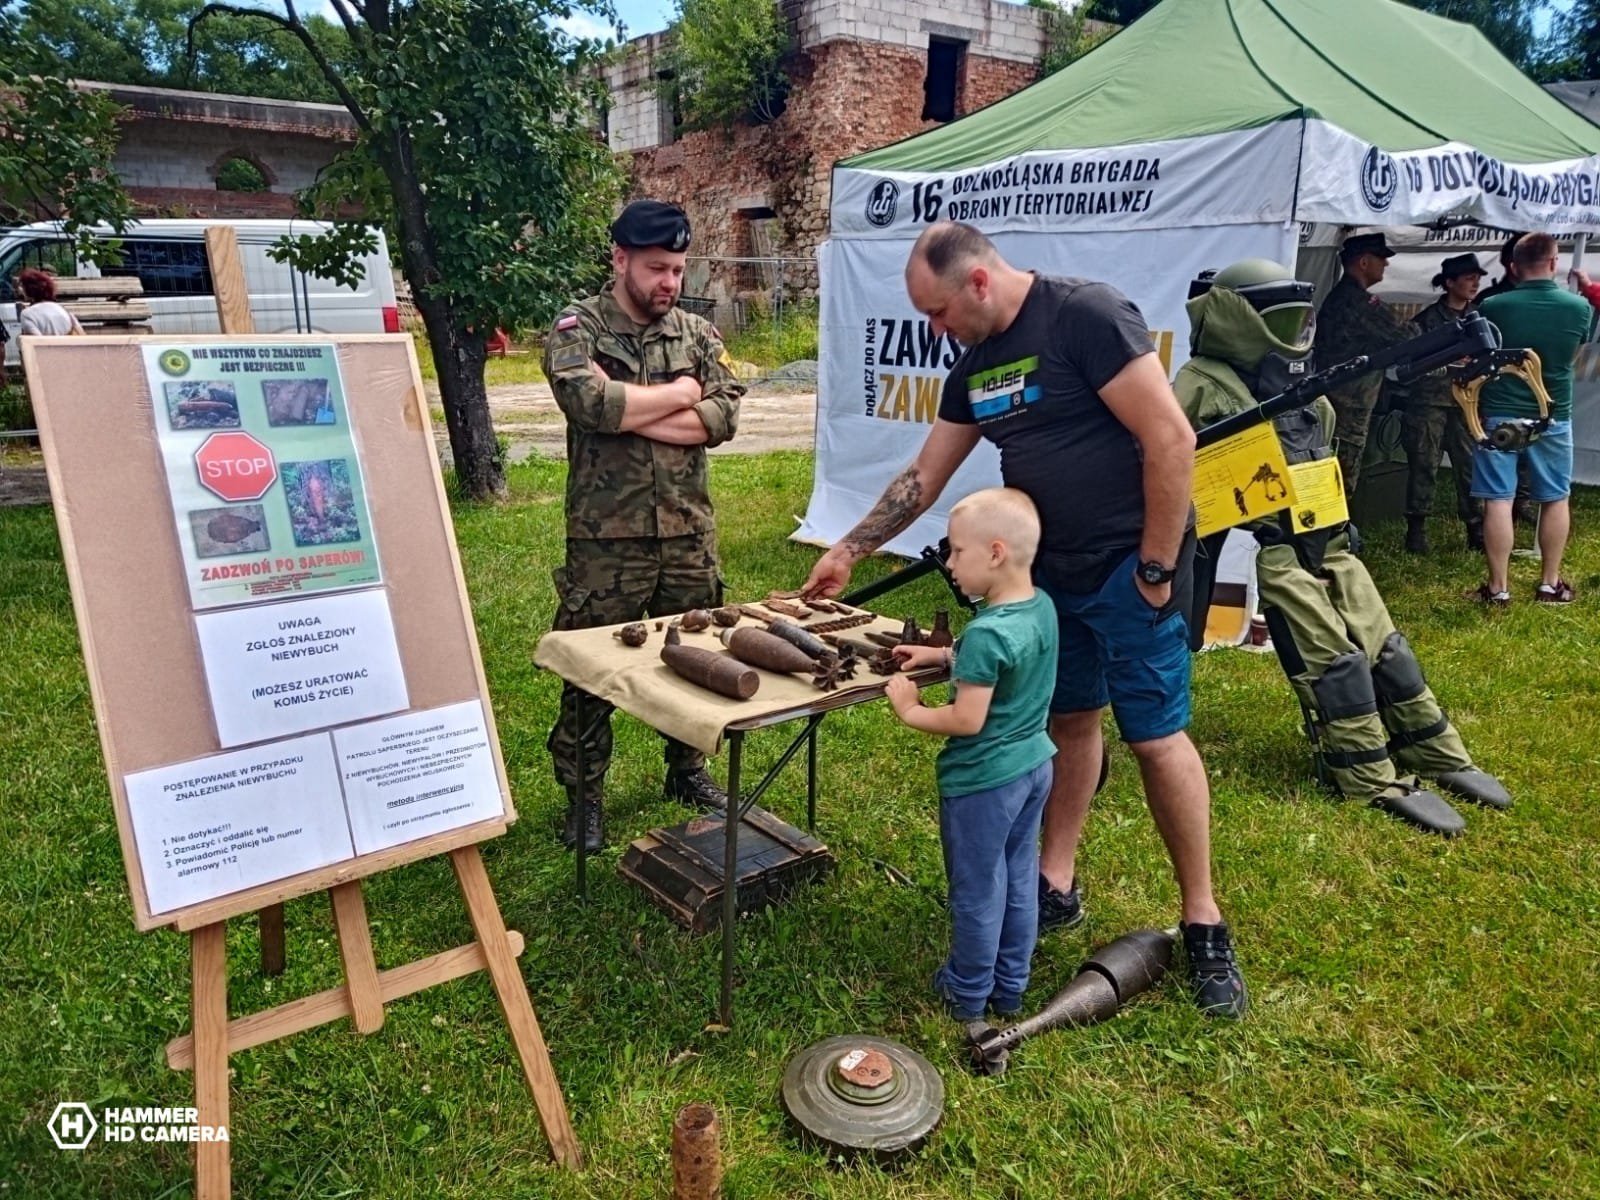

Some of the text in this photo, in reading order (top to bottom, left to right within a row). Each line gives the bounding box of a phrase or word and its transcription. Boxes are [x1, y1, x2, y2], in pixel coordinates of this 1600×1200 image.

[912, 158, 1160, 222] 16 DOLNOŚLĄSKA BRYGADA
[948, 189, 1153, 221] OBRONY TERYTORIALNEJ
[192, 349, 208, 359] NIE
[210, 349, 256, 359] WSZYSTKO
[258, 349, 270, 358] CO
[879, 319, 962, 370] ZAWS
[220, 362, 240, 372] JEST
[244, 362, 295, 372] BEZPIECZNE
[864, 318, 877, 417] DOŁĄCZ DO NAS
[876, 373, 941, 425] ZAW
[206, 458, 268, 478] STOP
[201, 559, 271, 582] ZADZWOŃ
[276, 558, 294, 572] PO
[278, 616, 322, 630] UWAGA
[246, 627, 356, 652] ZGŁOŚ ZNALEZIONY
[271, 644, 339, 660] NIEWYBUCH
[305, 668, 369, 688] URATOWAĆ
[273, 685, 354, 708] KOMUŚ ŻYCIE)
[346, 750, 377, 760] PATROLU
[377, 740, 421, 754] SAPERSKIEGO
[422, 736, 436, 744] JEST
[163, 755, 304, 792] POSTĘPOWANIE W PRZYPADKU
[175, 768, 297, 801] ZNALEZIENIA NIEWYBUCHU
[386, 796, 415, 809] metoda
[171, 834, 186, 845] Nie
[173, 839, 216, 856] Oznaczyć
[223, 828, 254, 843] oddalić
[256, 825, 270, 836] się
[175, 847, 229, 867] Powiadomić
[230, 838, 260, 853] Policję
[261, 833, 275, 844] lub
[277, 827, 303, 840] numer
[177, 855, 238, 878] alarmowy 112
